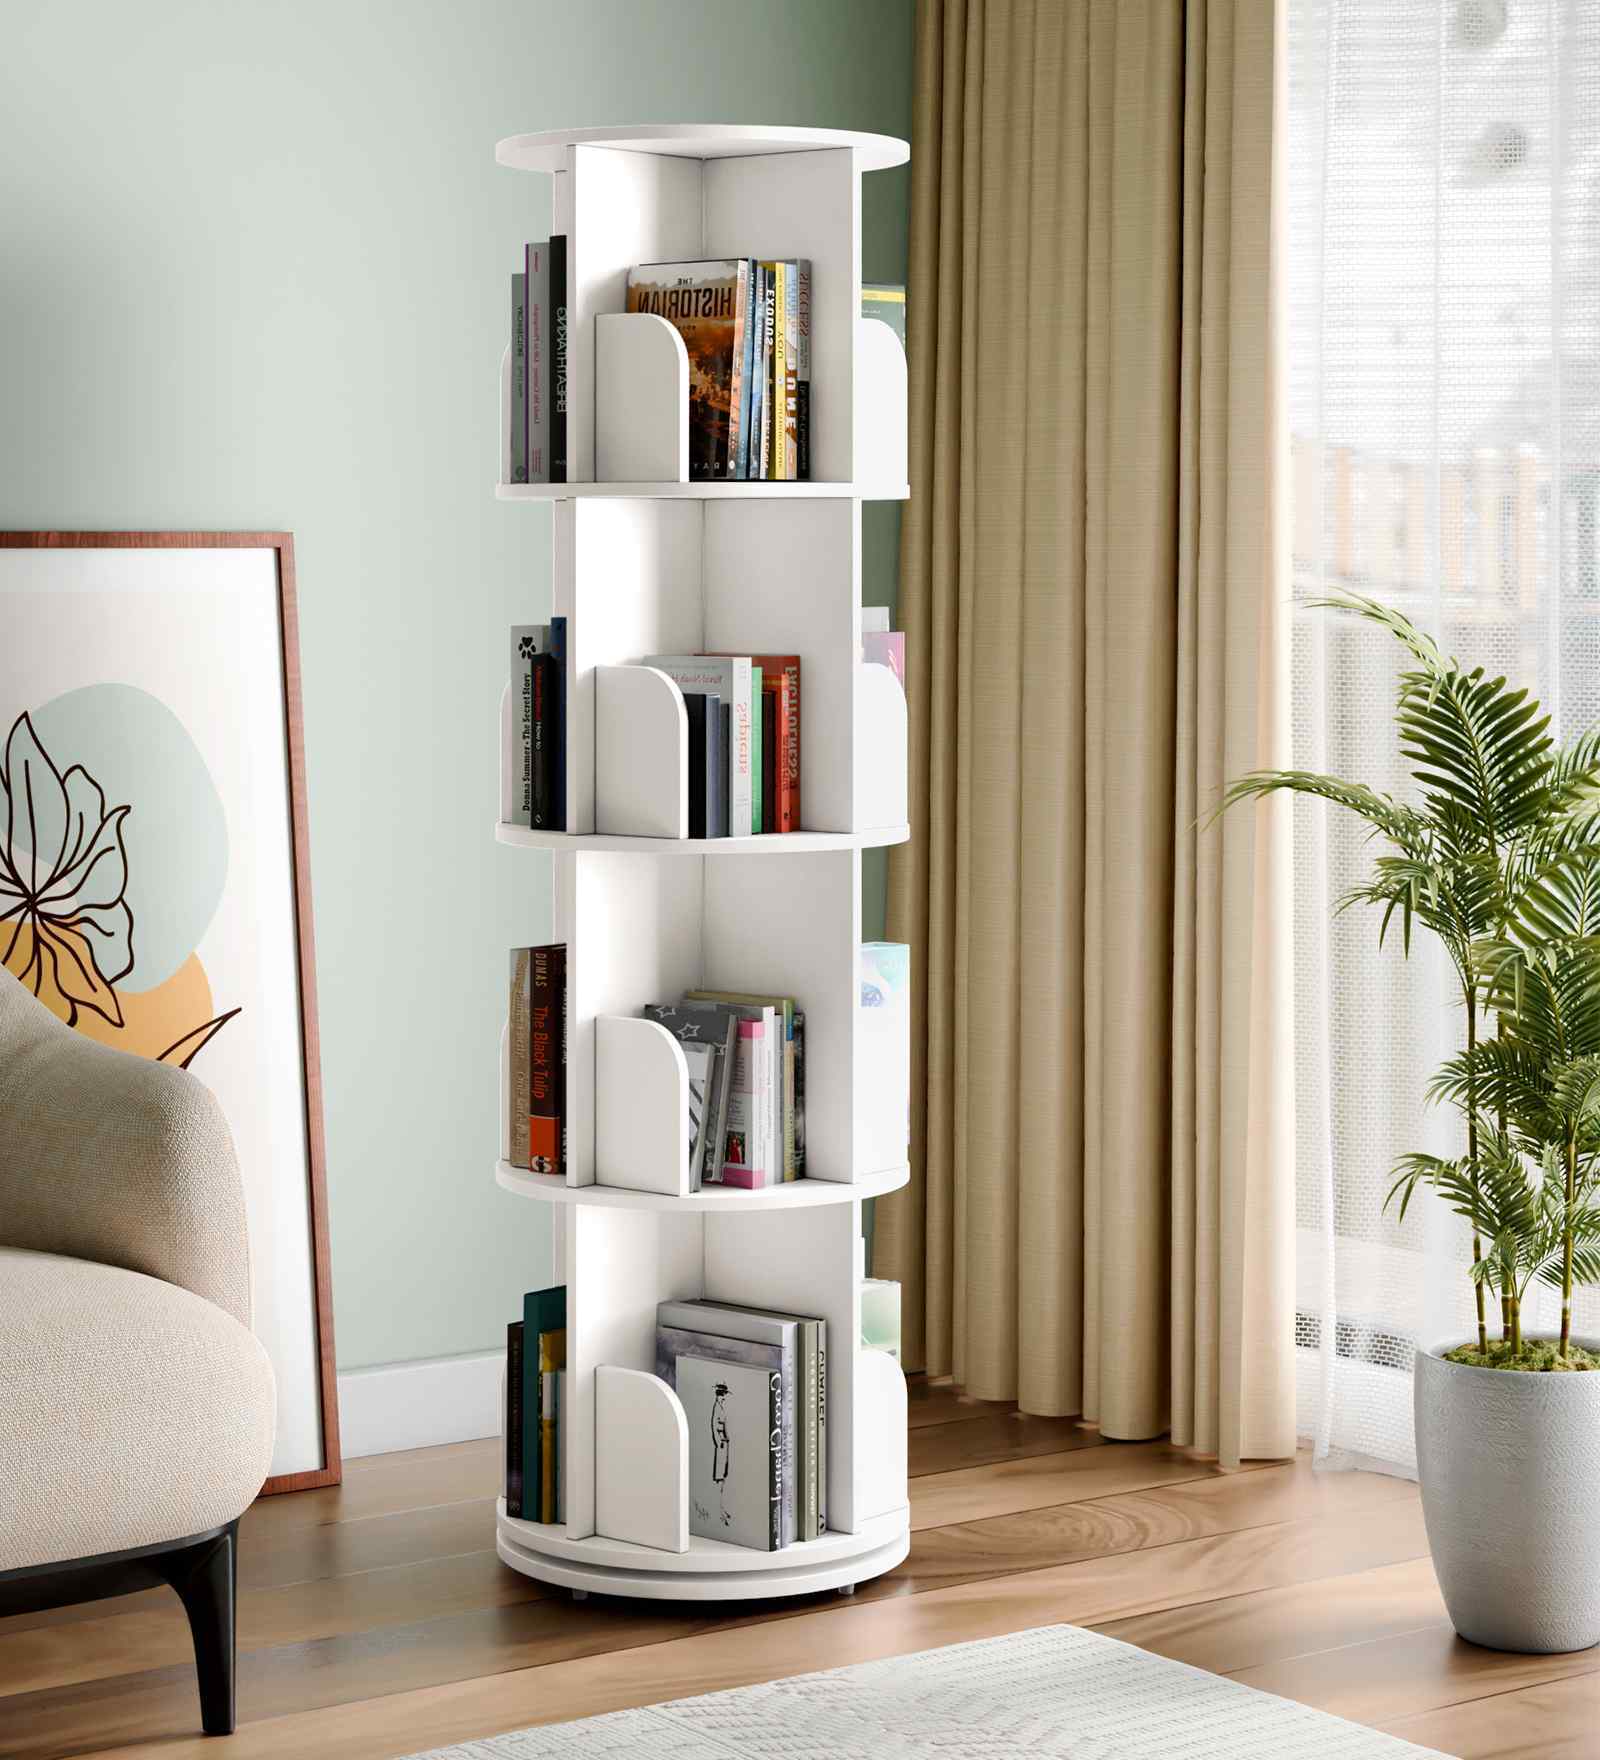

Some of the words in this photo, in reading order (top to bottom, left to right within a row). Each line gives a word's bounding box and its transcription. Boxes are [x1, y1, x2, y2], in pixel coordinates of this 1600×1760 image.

[522, 673, 532, 695] Story
[522, 696, 531, 723] Secret
[522, 724, 531, 740] The
[522, 747, 531, 782] Summer
[522, 784, 531, 811] Donna
[535, 953, 547, 988] DUMAS
[533, 1006, 548, 1029] The
[533, 1032, 548, 1066] Black
[531, 1071, 545, 1099] Tulip
